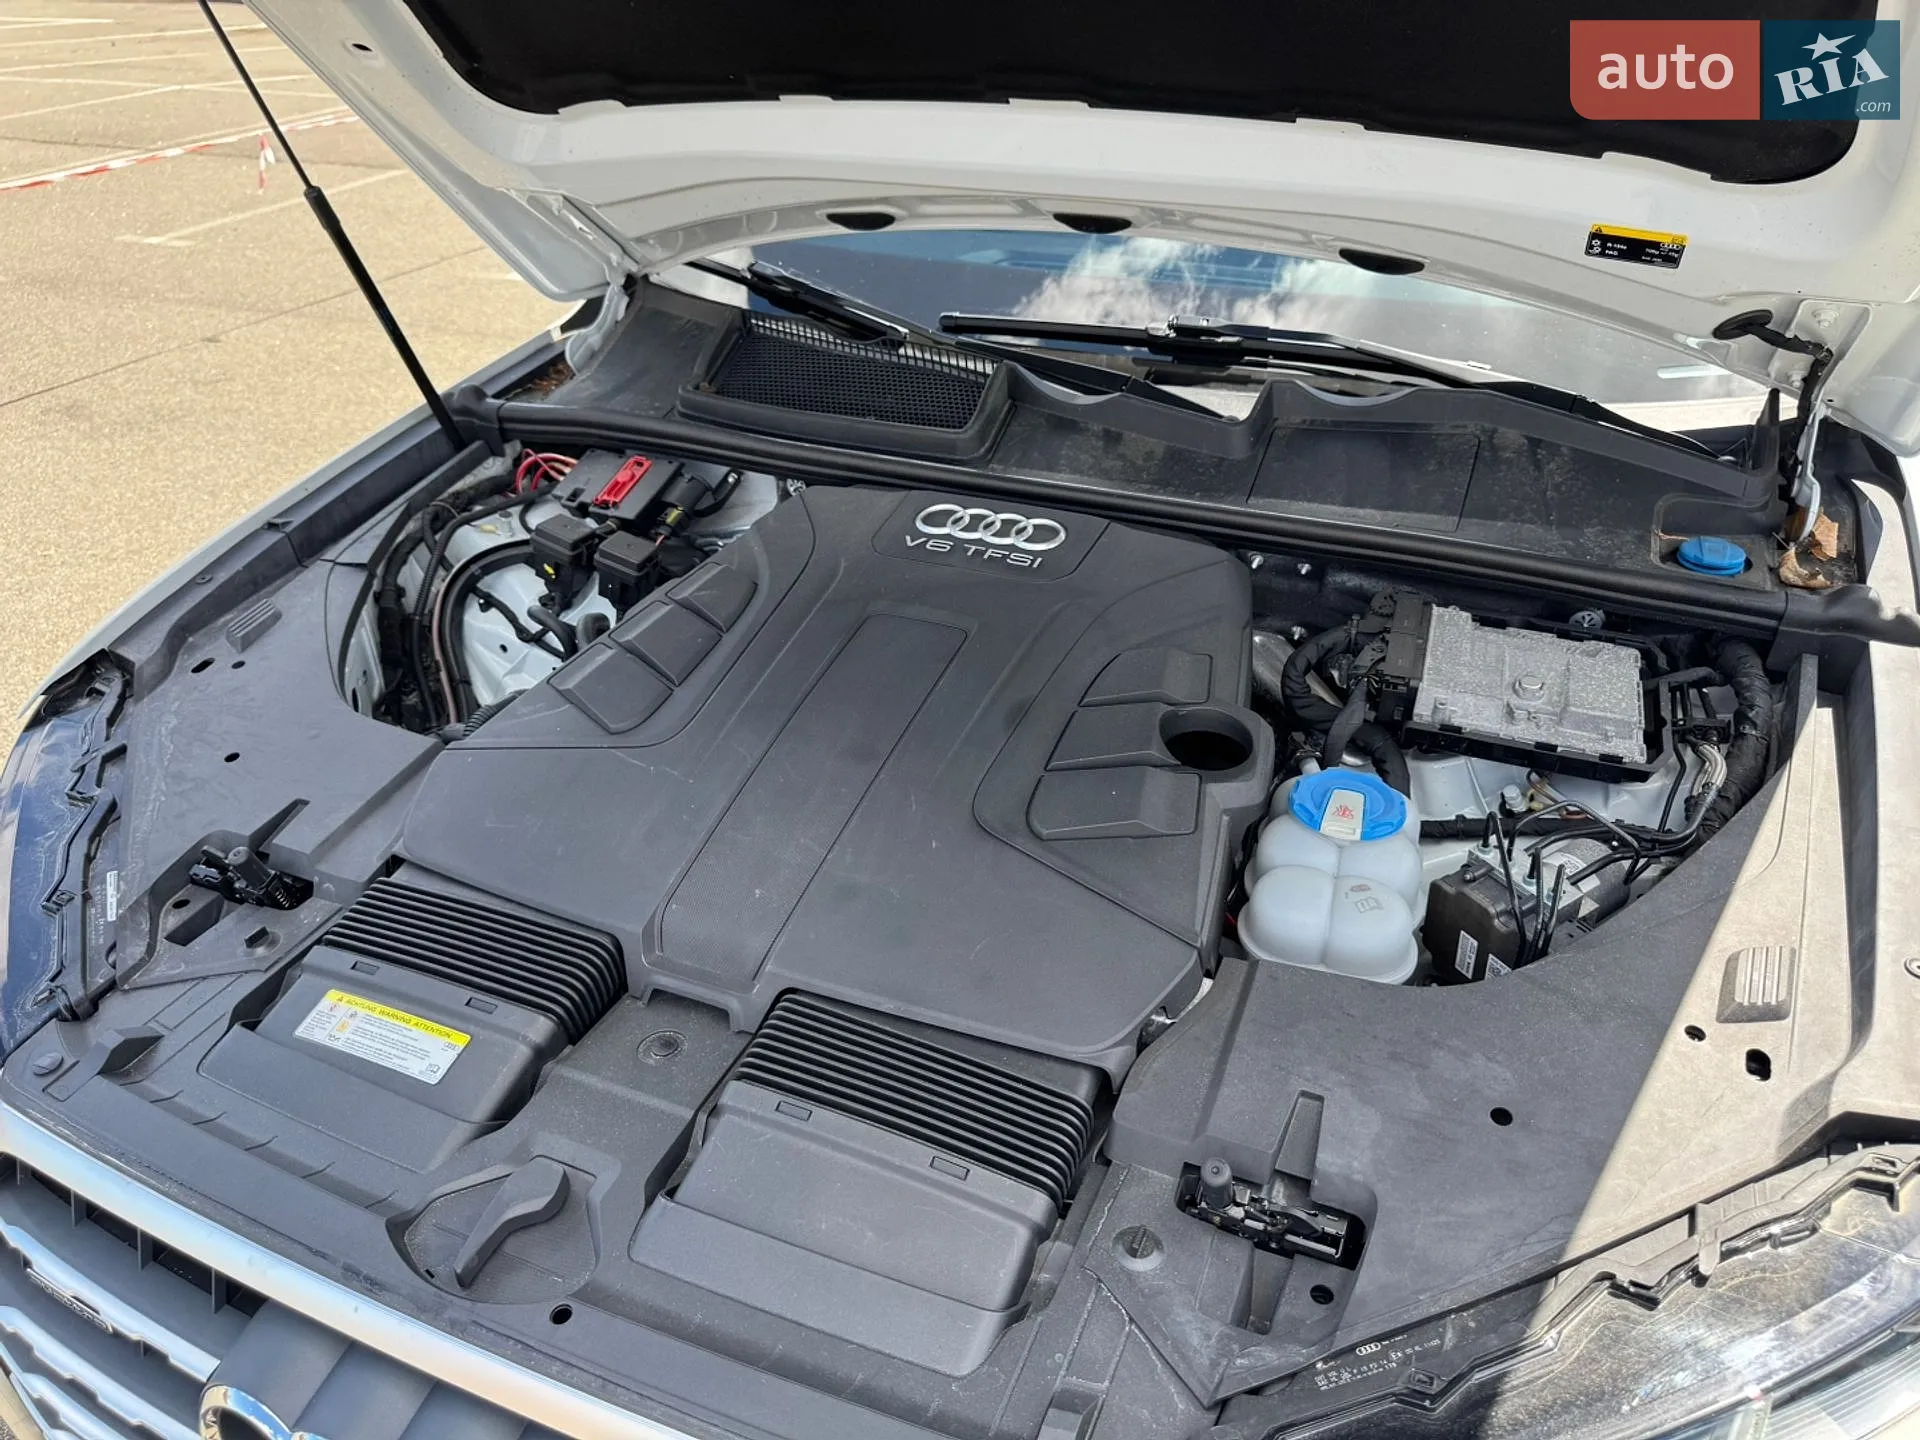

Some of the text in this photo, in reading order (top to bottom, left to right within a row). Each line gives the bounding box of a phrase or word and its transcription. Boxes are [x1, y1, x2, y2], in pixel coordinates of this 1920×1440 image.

[904, 535, 1043, 568] V6 TFSI
[346, 997, 378, 1012] ACHTUNG
[378, 1007, 412, 1024] WARNING
[413, 1018, 453, 1039] ATTENTION
